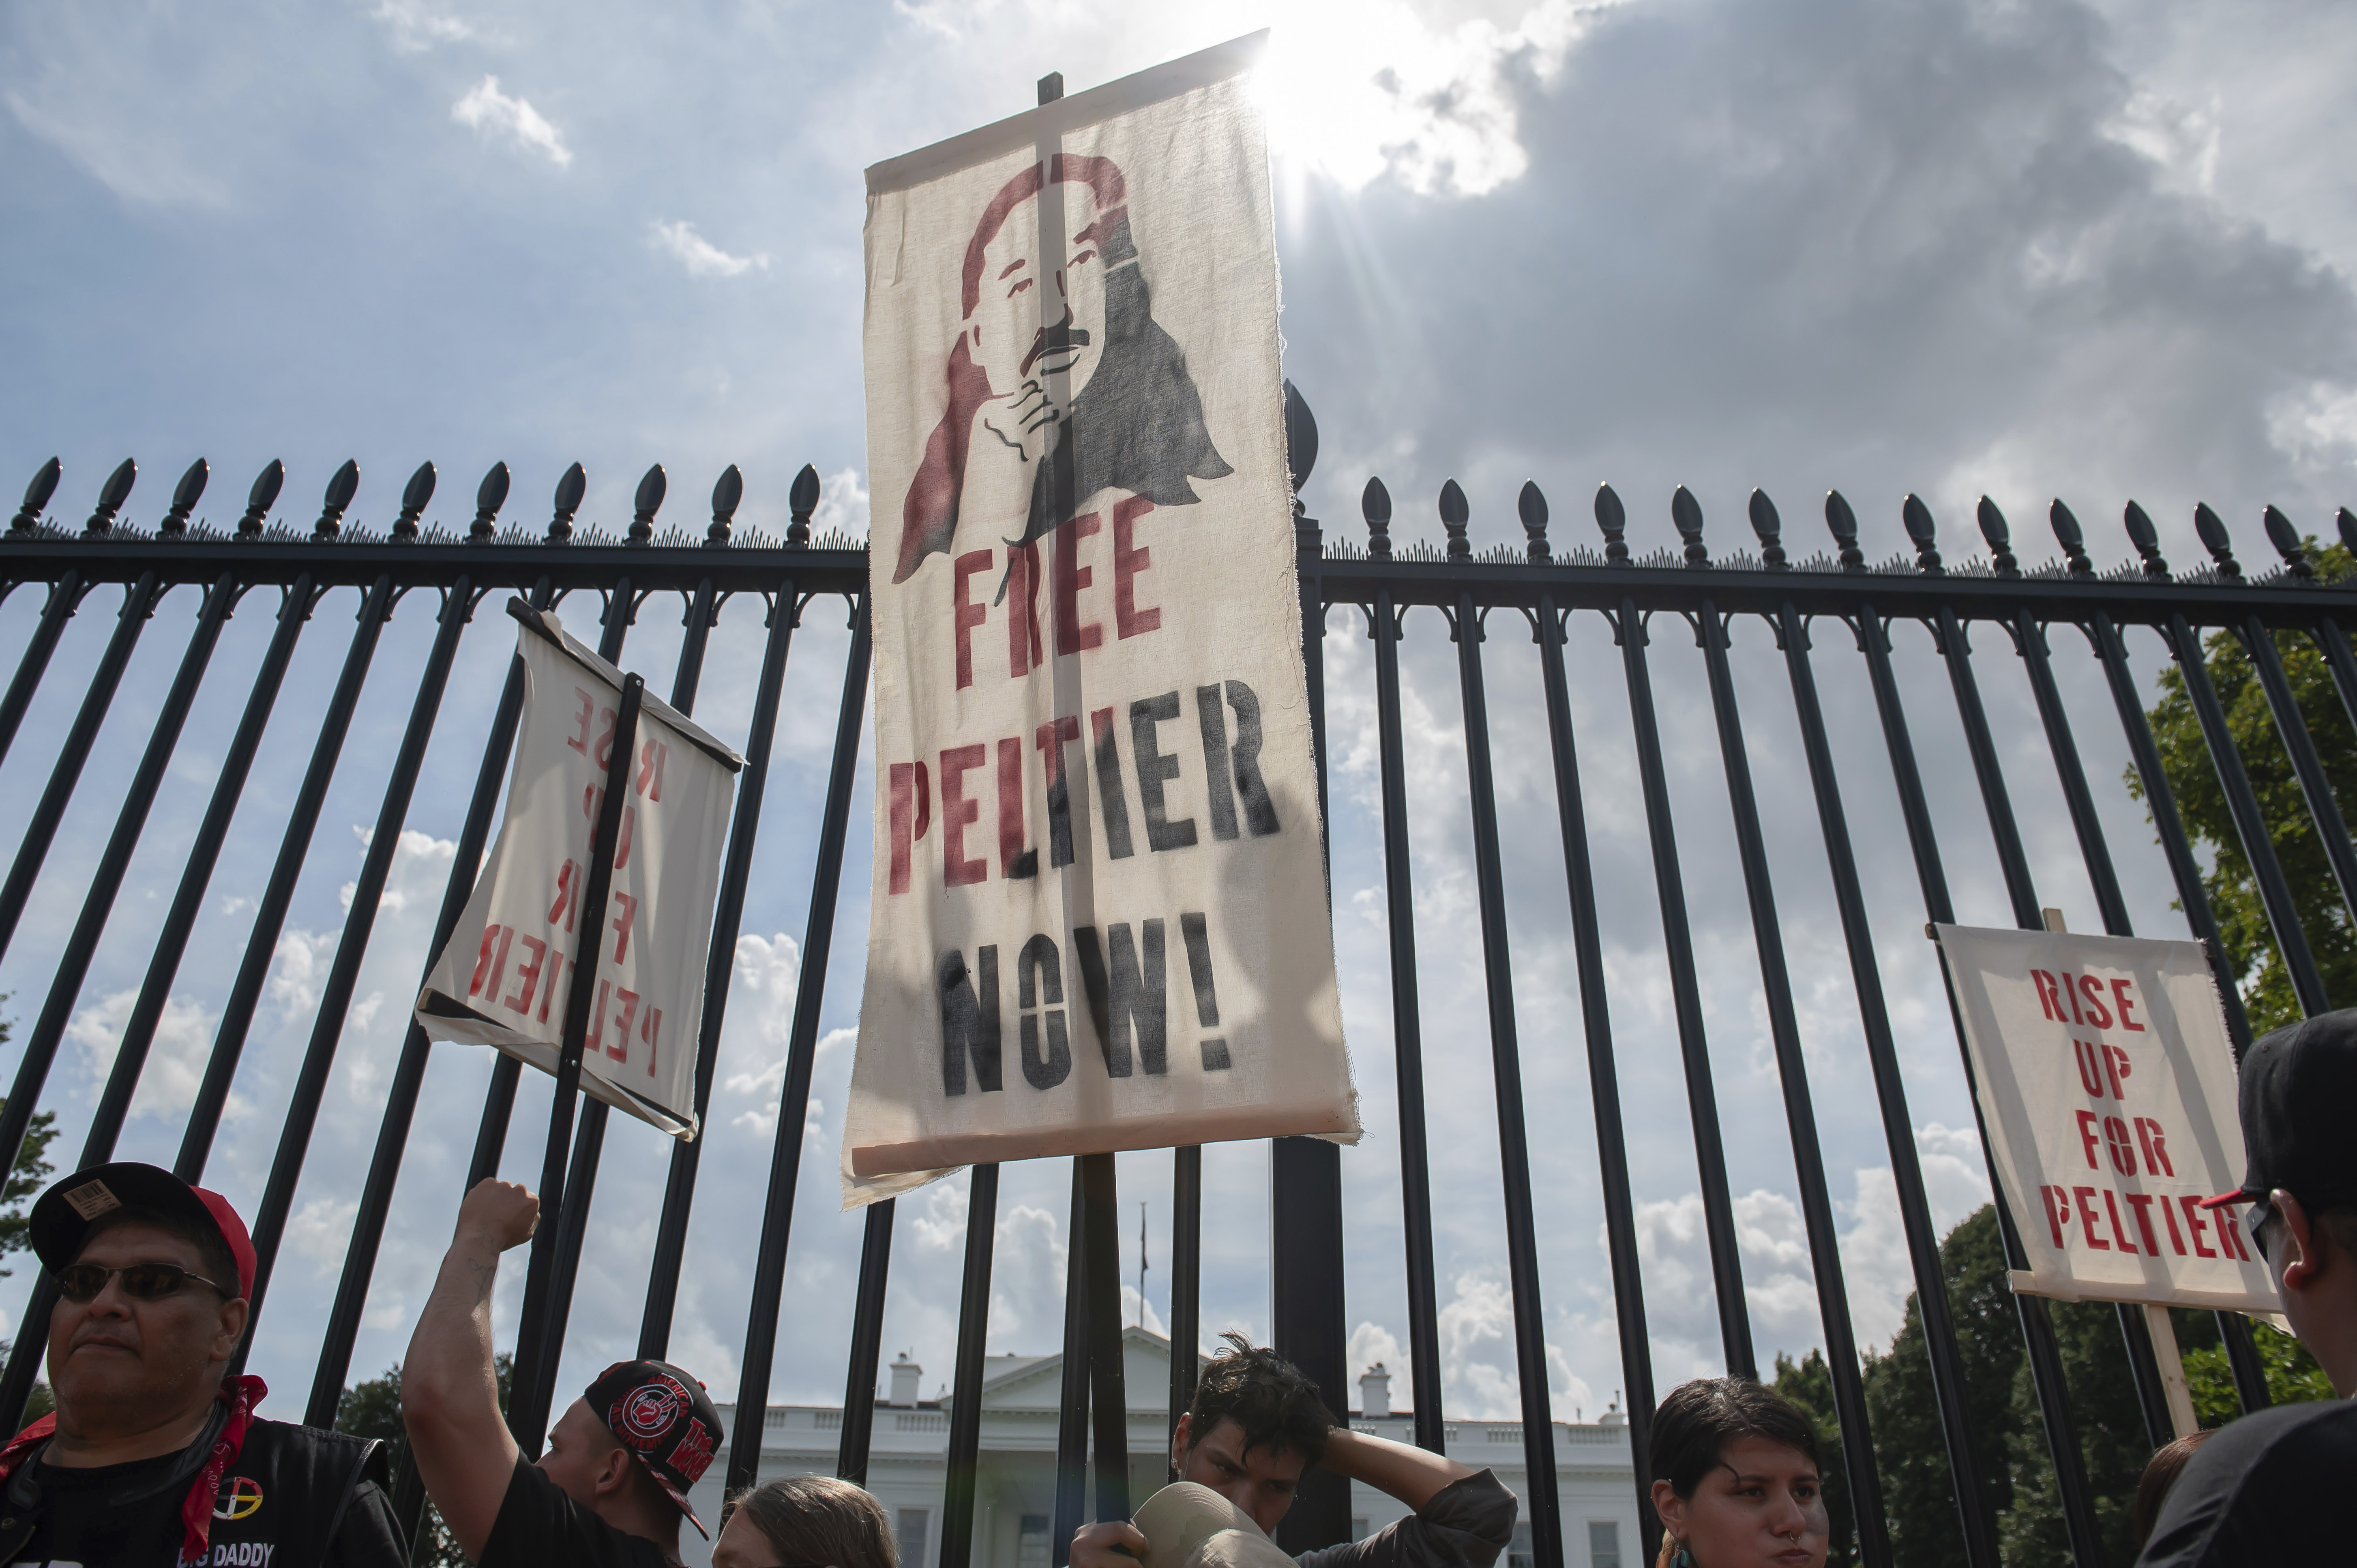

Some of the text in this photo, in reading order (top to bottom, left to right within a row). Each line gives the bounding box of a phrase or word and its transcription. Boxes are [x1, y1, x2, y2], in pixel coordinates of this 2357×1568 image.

[953, 490, 1161, 691] FREE
[888, 679, 1280, 896] PELTIER
[938, 912, 1232, 1097] NOW!
[2030, 969, 2146, 1032] RISE
[2074, 1039, 2132, 1101] UP
[2075, 1109, 2175, 1178] FOR
[2040, 1185, 2252, 1262] PELTIER
[611, 1386, 637, 1424] DIAN
[647, 1375, 689, 1418] AMERICAN
[684, 1416, 713, 1453] The
[176, 1542, 275, 1568] BG DADDY
